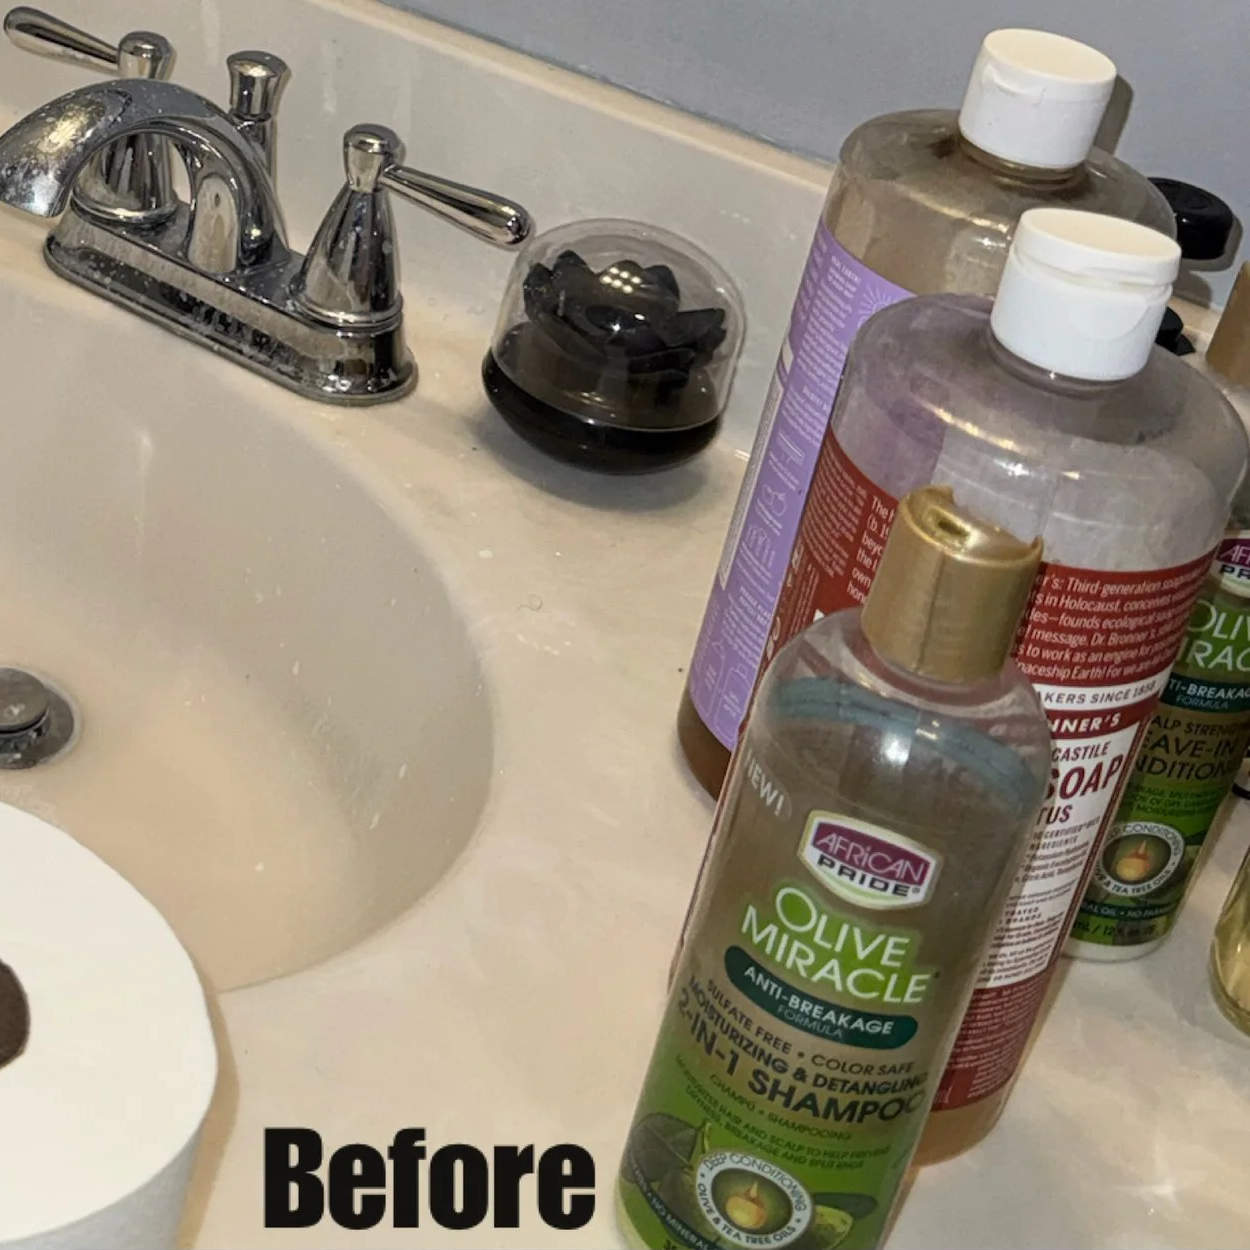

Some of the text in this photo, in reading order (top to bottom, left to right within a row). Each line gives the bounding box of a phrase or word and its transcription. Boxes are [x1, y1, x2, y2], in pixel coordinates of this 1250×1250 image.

[871, 495, 888, 520] The
[1041, 647, 1070, 661] work
[1090, 689, 1130, 704] SINCE
[1176, 694, 1228, 709] FORMULA
[1051, 740, 1111, 762] CASTILE
[815, 833, 925, 883] AFRICAN
[817, 854, 911, 897] PRIDE
[775, 887, 911, 968] OLIVE
[741, 904, 930, 1004] MIRACLE
[743, 965, 895, 1035] ANTI-BREAKAGE
[775, 1004, 844, 1040] FORMULA
[689, 975, 789, 1075] MOISTURIZING
[792, 1067, 807, 1084] &
[812, 1071, 929, 1097] DETANGLING
[706, 979, 753, 1031] SULFATE
[755, 1025, 793, 1055] FREE
[810, 1053, 875, 1076] COLOR
[678, 987, 927, 1125] 2-IN-1 SHAMPOO
[767, 1112, 853, 1142] SHAMPOOING
[728, 1152, 808, 1212] CONDITIONING
[697, 1182, 713, 1217] OLIVE
[721, 1223, 743, 1242] TEA
[743, 1232, 772, 1245] TREE
[772, 1224, 797, 1243] OILS
